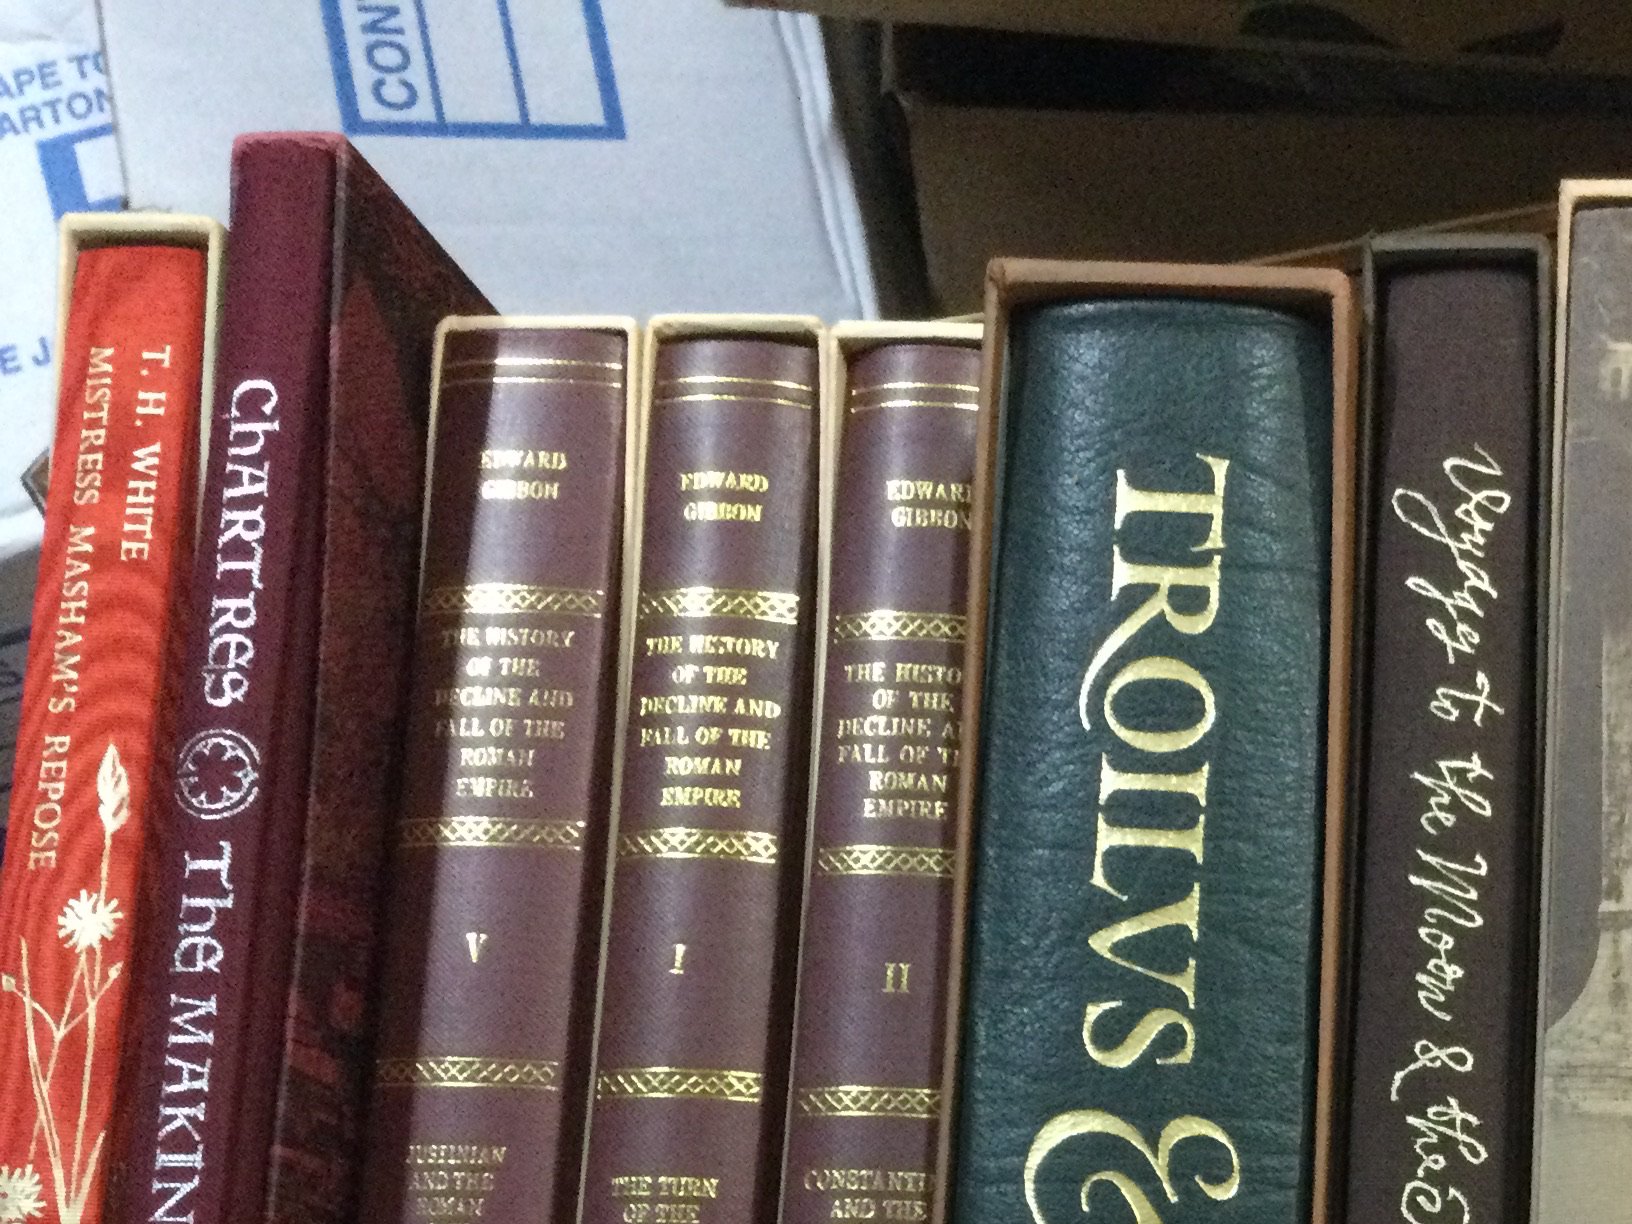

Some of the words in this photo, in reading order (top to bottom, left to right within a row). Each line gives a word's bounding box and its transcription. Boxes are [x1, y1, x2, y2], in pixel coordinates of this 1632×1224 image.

[139, 344, 171, 377] T.
[134, 390, 167, 428] H.
[73, 346, 115, 506] MISTRESS
[680, 470, 769, 493] EDWARD
[120, 441, 162, 562] WHITE
[48, 524, 96, 715] MASHAM'S
[844, 661, 885, 683] THE
[733, 697, 782, 720] AND
[872, 688, 899, 710] OF
[1428, 670, 1505, 727] to
[728, 727, 772, 750] THE
[838, 715, 932, 740] DECLINE
[838, 744, 889, 764] FALL
[899, 744, 930, 764] OF
[1079, 453, 1230, 1068] TROILVS
[665, 756, 743, 777] ROMAN
[869, 770, 948, 792] ROMAN
[28, 734, 71, 871] REPOSE
[660, 787, 742, 809] EMPIRE
[863, 798, 948, 819] EMPIRE
[882, 963, 911, 994] II
[1390, 1039, 1475, 1102] &
[830, 1198, 876, 1219] AND
